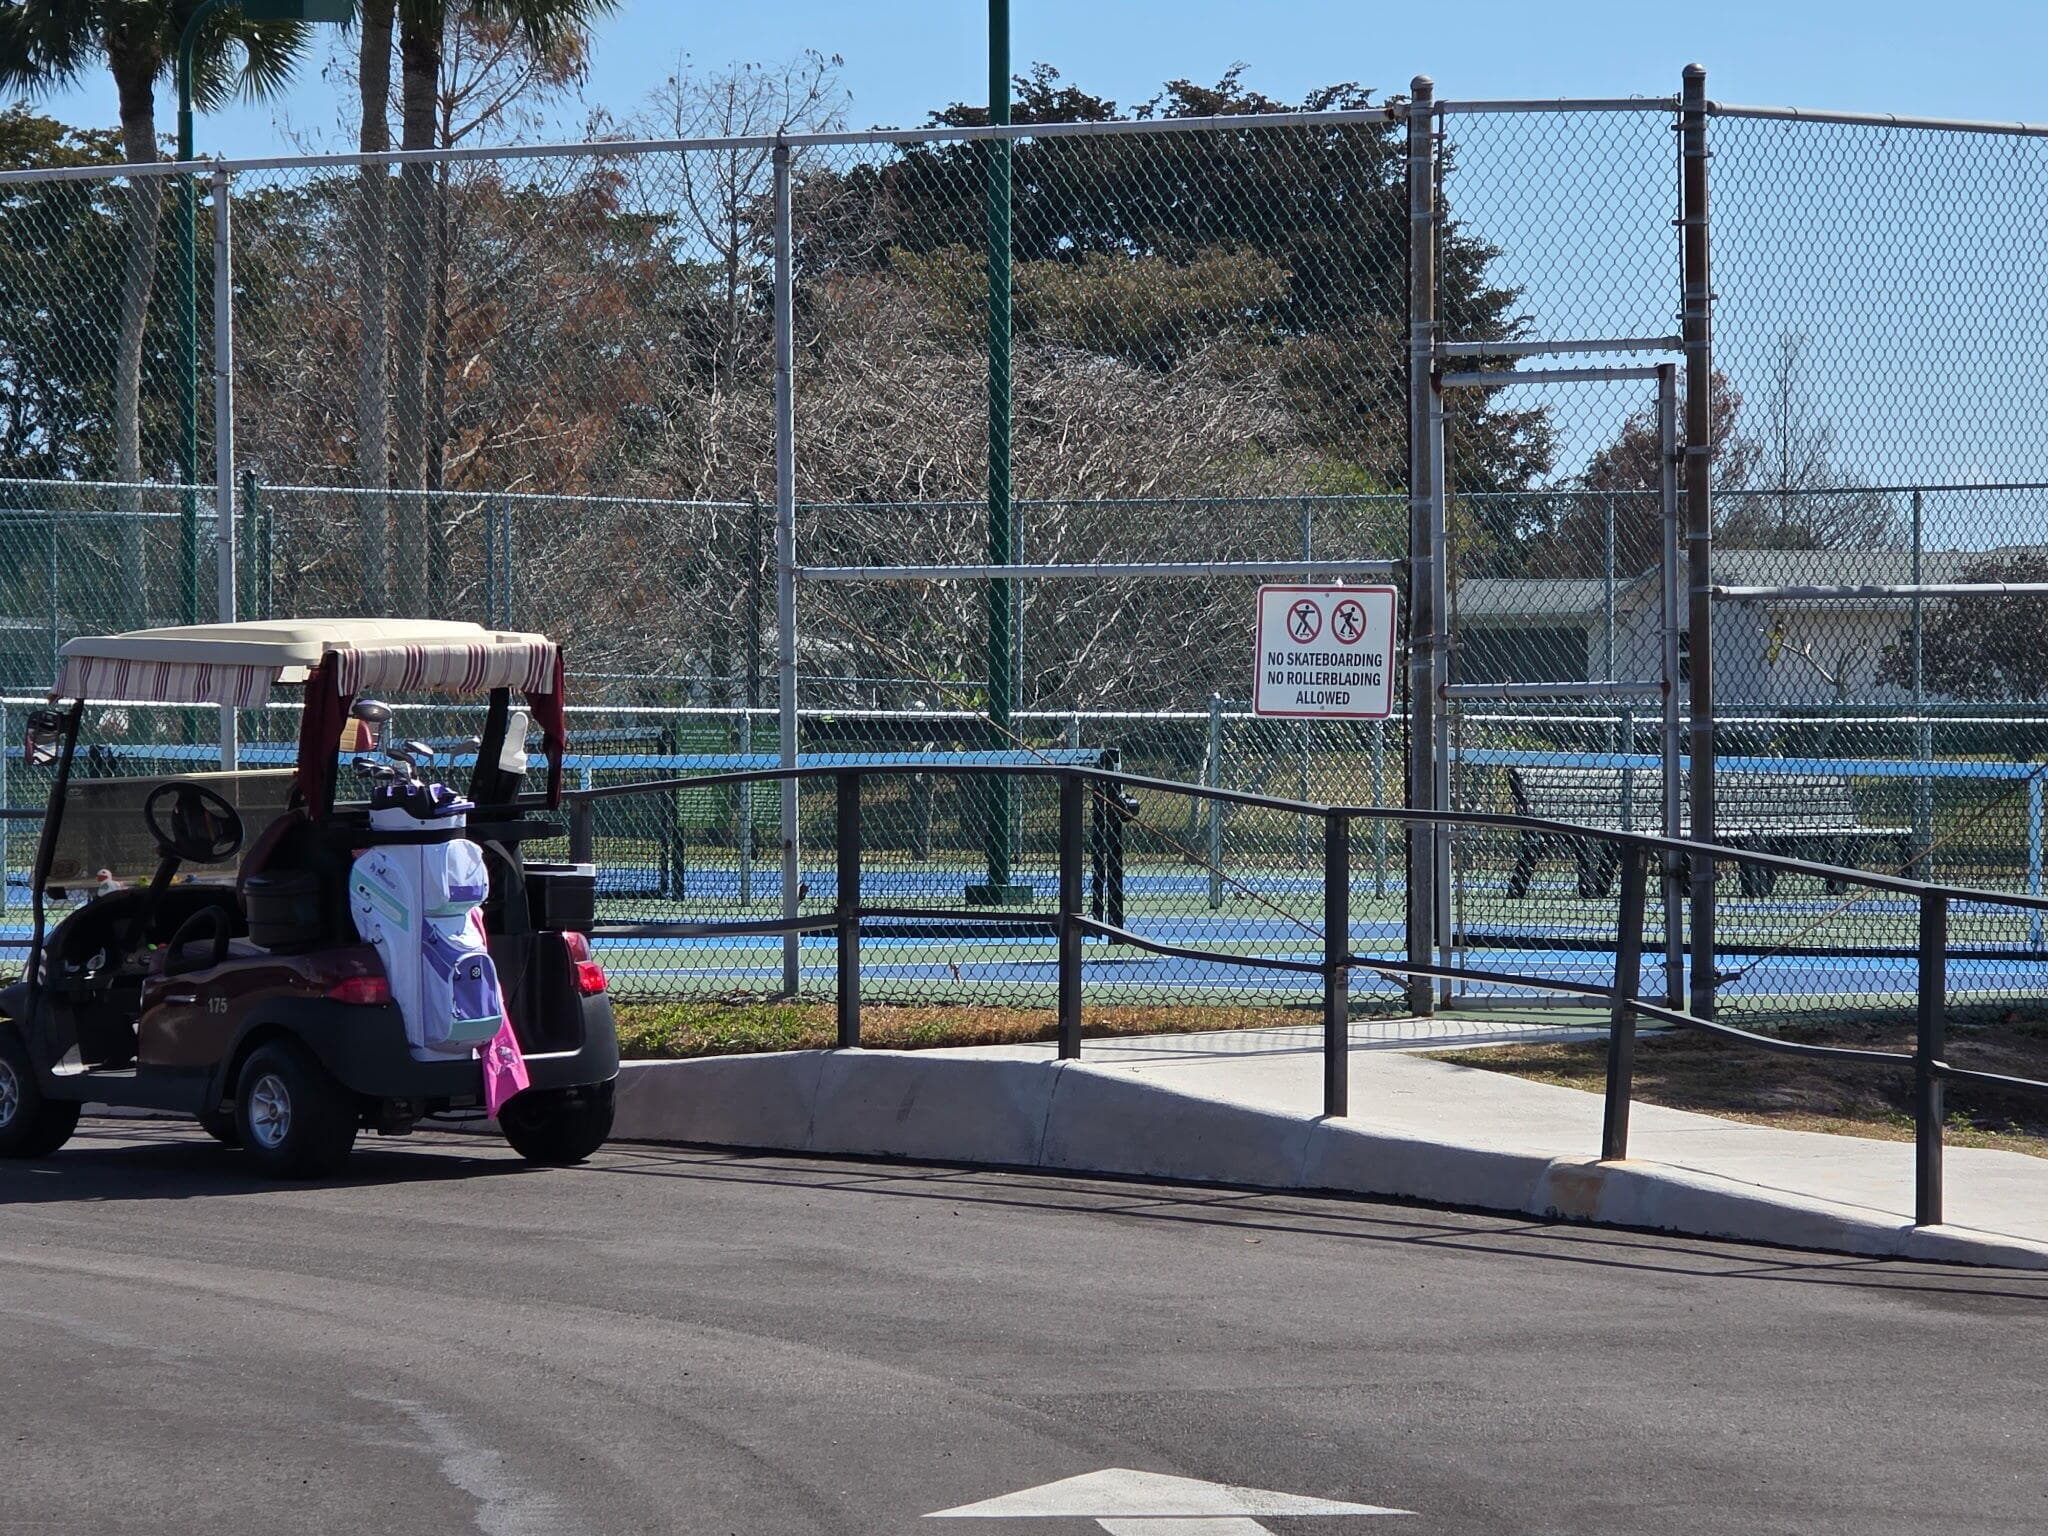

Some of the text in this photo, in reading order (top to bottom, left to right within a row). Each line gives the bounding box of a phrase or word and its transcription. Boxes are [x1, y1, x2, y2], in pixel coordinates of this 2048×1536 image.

[1268, 652, 1383, 667] NO SKATEBOARDING
[1267, 671, 1381, 686] NO ROLLERBLADING
[1295, 690, 1351, 705] ALLOWED
[207, 998, 228, 1014] 175
